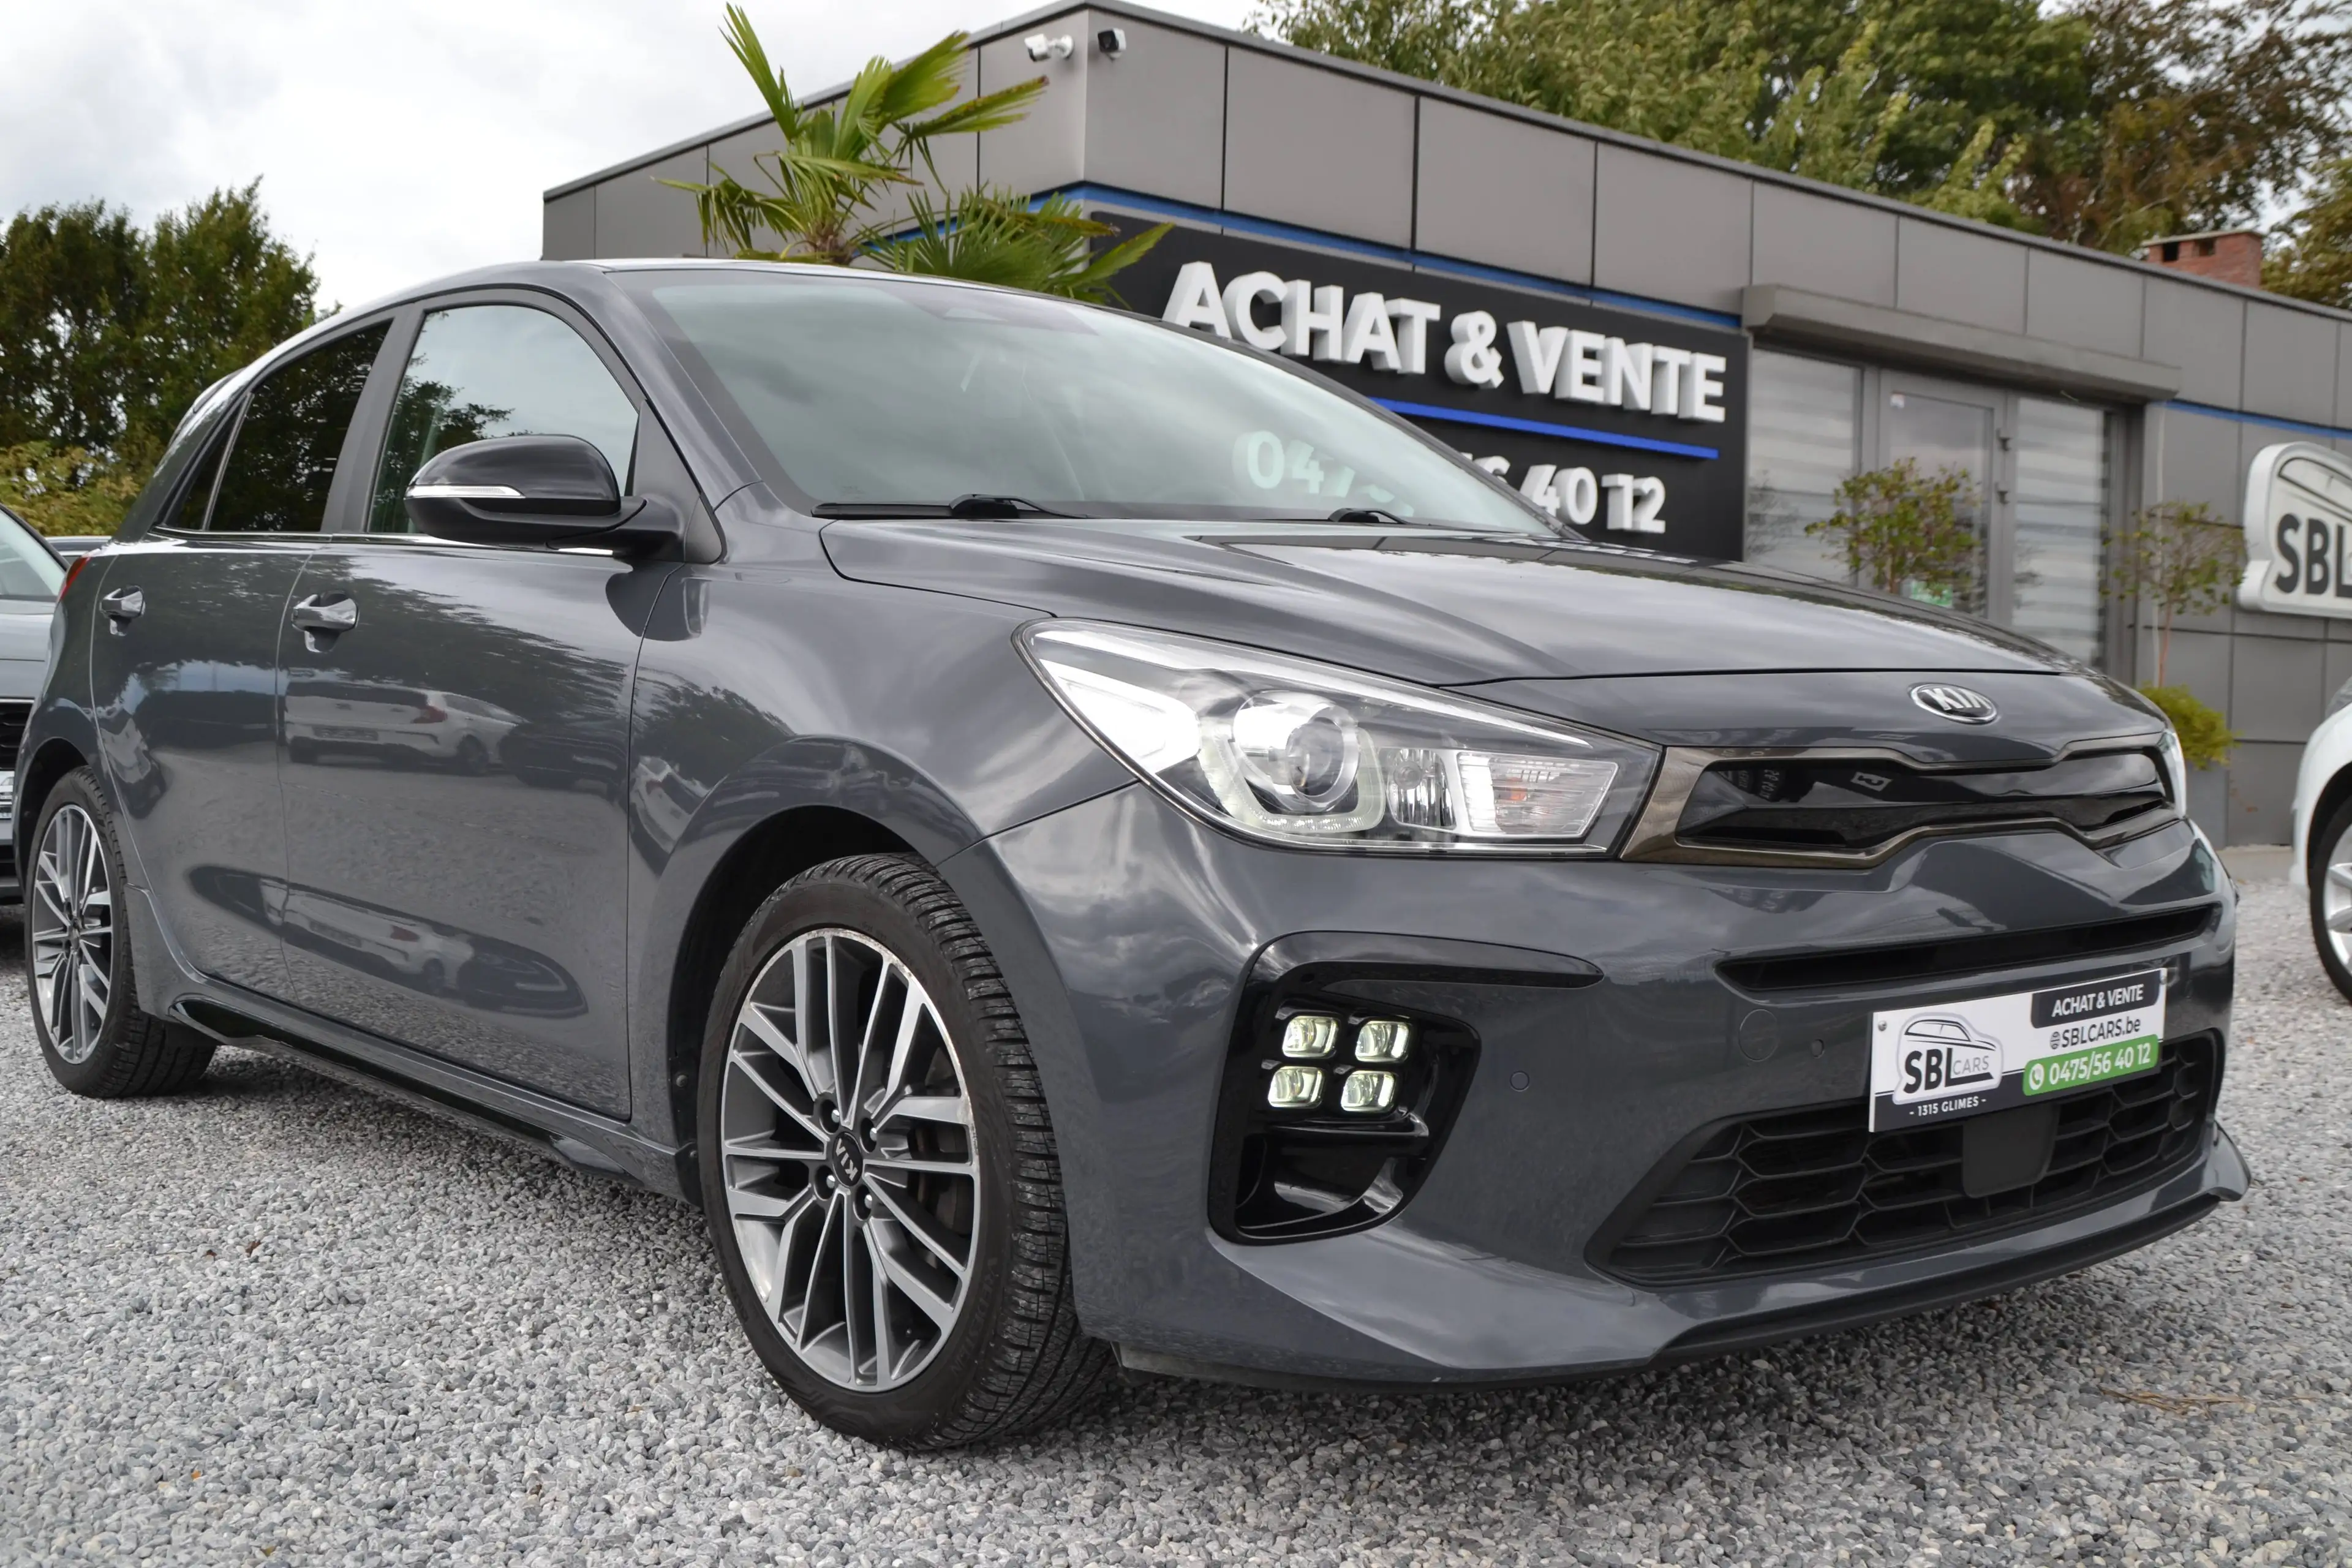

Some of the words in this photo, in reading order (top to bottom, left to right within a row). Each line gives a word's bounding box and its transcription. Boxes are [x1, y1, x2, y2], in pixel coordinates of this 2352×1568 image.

[1163, 262, 1441, 374] ACHAT
[1444, 310, 1504, 388] &
[1506, 320, 1727, 423] VENTE
[1601, 473, 1666, 533] 12
[2274, 513, 2352, 598] SBL
[1921, 688, 1992, 710] KIA
[2051, 993, 2096, 1017] ACHAT
[2096, 992, 2106, 1009] &
[2107, 984, 2144, 1006] VENTE
[1903, 1047, 1994, 1094] SBL
[1953, 1055, 1989, 1075] CARS
[2049, 1050, 2112, 1085] 0475/56
[2114, 1047, 2134, 1069] 40
[2137, 1042, 2151, 1065] 12
[1918, 1103, 1939, 1117] 1315
[1941, 1096, 1979, 1112] GLIMES
